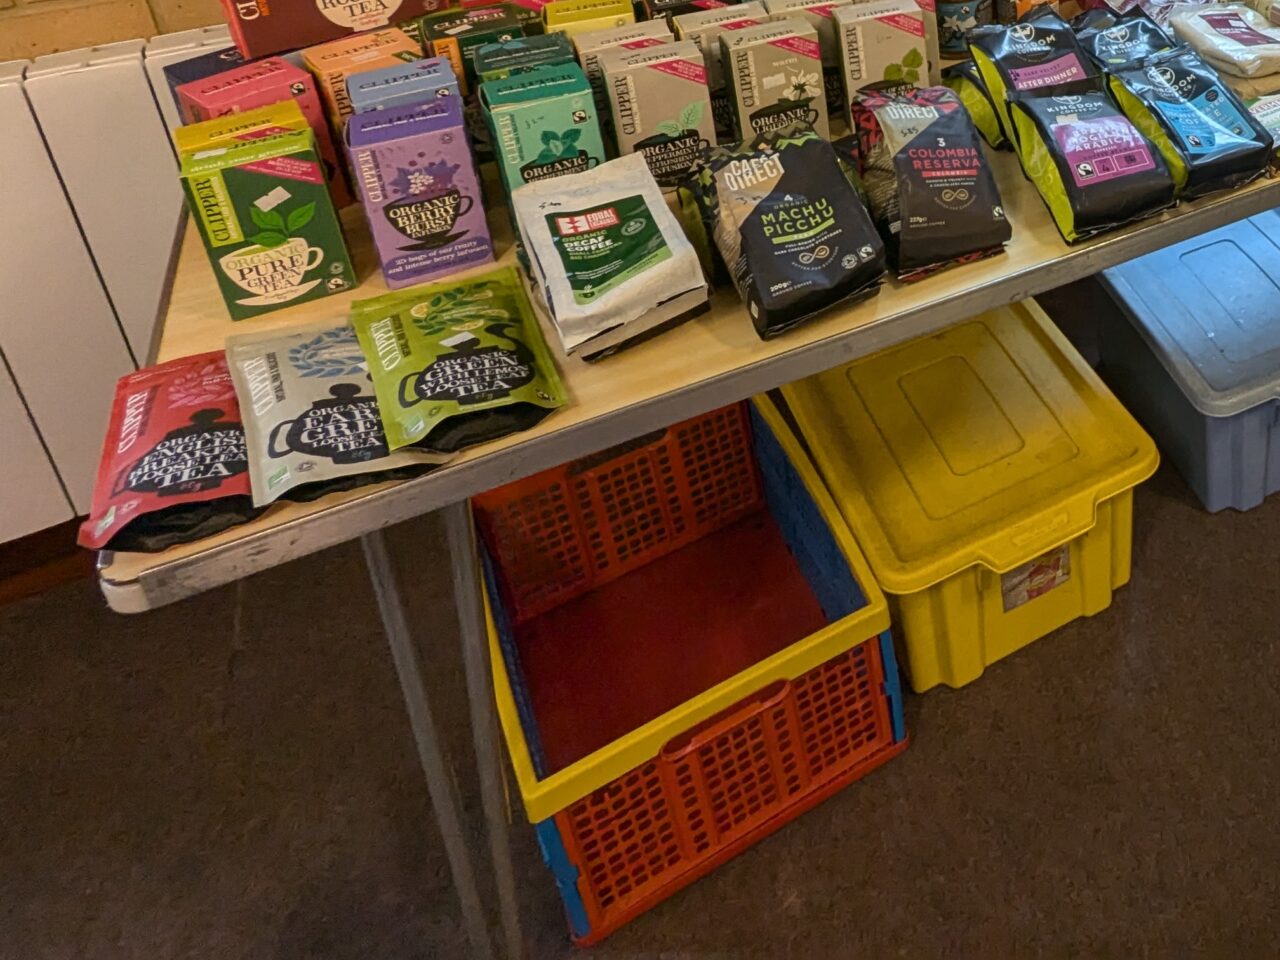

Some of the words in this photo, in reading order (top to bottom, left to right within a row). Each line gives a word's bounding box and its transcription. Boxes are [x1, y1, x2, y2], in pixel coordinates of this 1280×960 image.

[433, 12, 507, 31] CLIPPER
[846, 26, 862, 81] CLIPPER
[1101, 39, 1141, 51] KINGDO
[737, 52, 754, 107] CLIPPER
[1017, 78, 1044, 89] AFTER
[1045, 67, 1078, 83] DINNER
[614, 76, 636, 135] CLIPPER
[1047, 102, 1103, 113] KINGDOM
[752, 107, 808, 128] ORGANIC
[909, 147, 979, 159] COLOMBIA
[936, 137, 946, 147] 3
[646, 147, 698, 163] EPPERMINT
[912, 158, 981, 170] RESERVA
[358, 150, 382, 203] CLIPPER
[523, 156, 588, 179] ORGANIC
[724, 152, 785, 191] DIRECT
[195, 177, 231, 242] CLIPPER
[389, 194, 460, 219] ORGANIC
[397, 204, 457, 227] BERRY
[588, 208, 615, 221] EQUAL
[761, 198, 827, 225] MACHU
[405, 214, 454, 234] BURST
[412, 225, 451, 239] INFUSION
[763, 206, 834, 237] PICCHU
[562, 229, 609, 242] ORGANIC
[563, 236, 606, 248] DECAF
[566, 239, 614, 253] COFFEE
[226, 238, 306, 271] ORGANIC
[237, 254, 305, 283] PURE
[247, 268, 302, 289] GREEN
[259, 279, 296, 295] TEA
[370, 318, 402, 371] CLIPPER
[425, 355, 519, 381] GREEN
[433, 350, 510, 369] ORGANIC
[244, 356, 274, 417] CLIPPER
[420, 370, 470, 391] WITH
[474, 364, 529, 377] LEMON
[425, 377, 481, 398] LOOSE
[485, 370, 530, 382] LEAF
[450, 380, 513, 398] TEA
[303, 408, 380, 431] EAR
[309, 401, 379, 417] ORGANI
[117, 390, 148, 455] CLIPPER
[300, 419, 378, 444] GRE
[156, 429, 240, 451] ORGANIC
[332, 437, 384, 452] TEA
[129, 445, 247, 481] BREAKFAS
[129, 459, 199, 488] LOOSE
[203, 453, 247, 465] LEA
[158, 463, 233, 489] TEA
